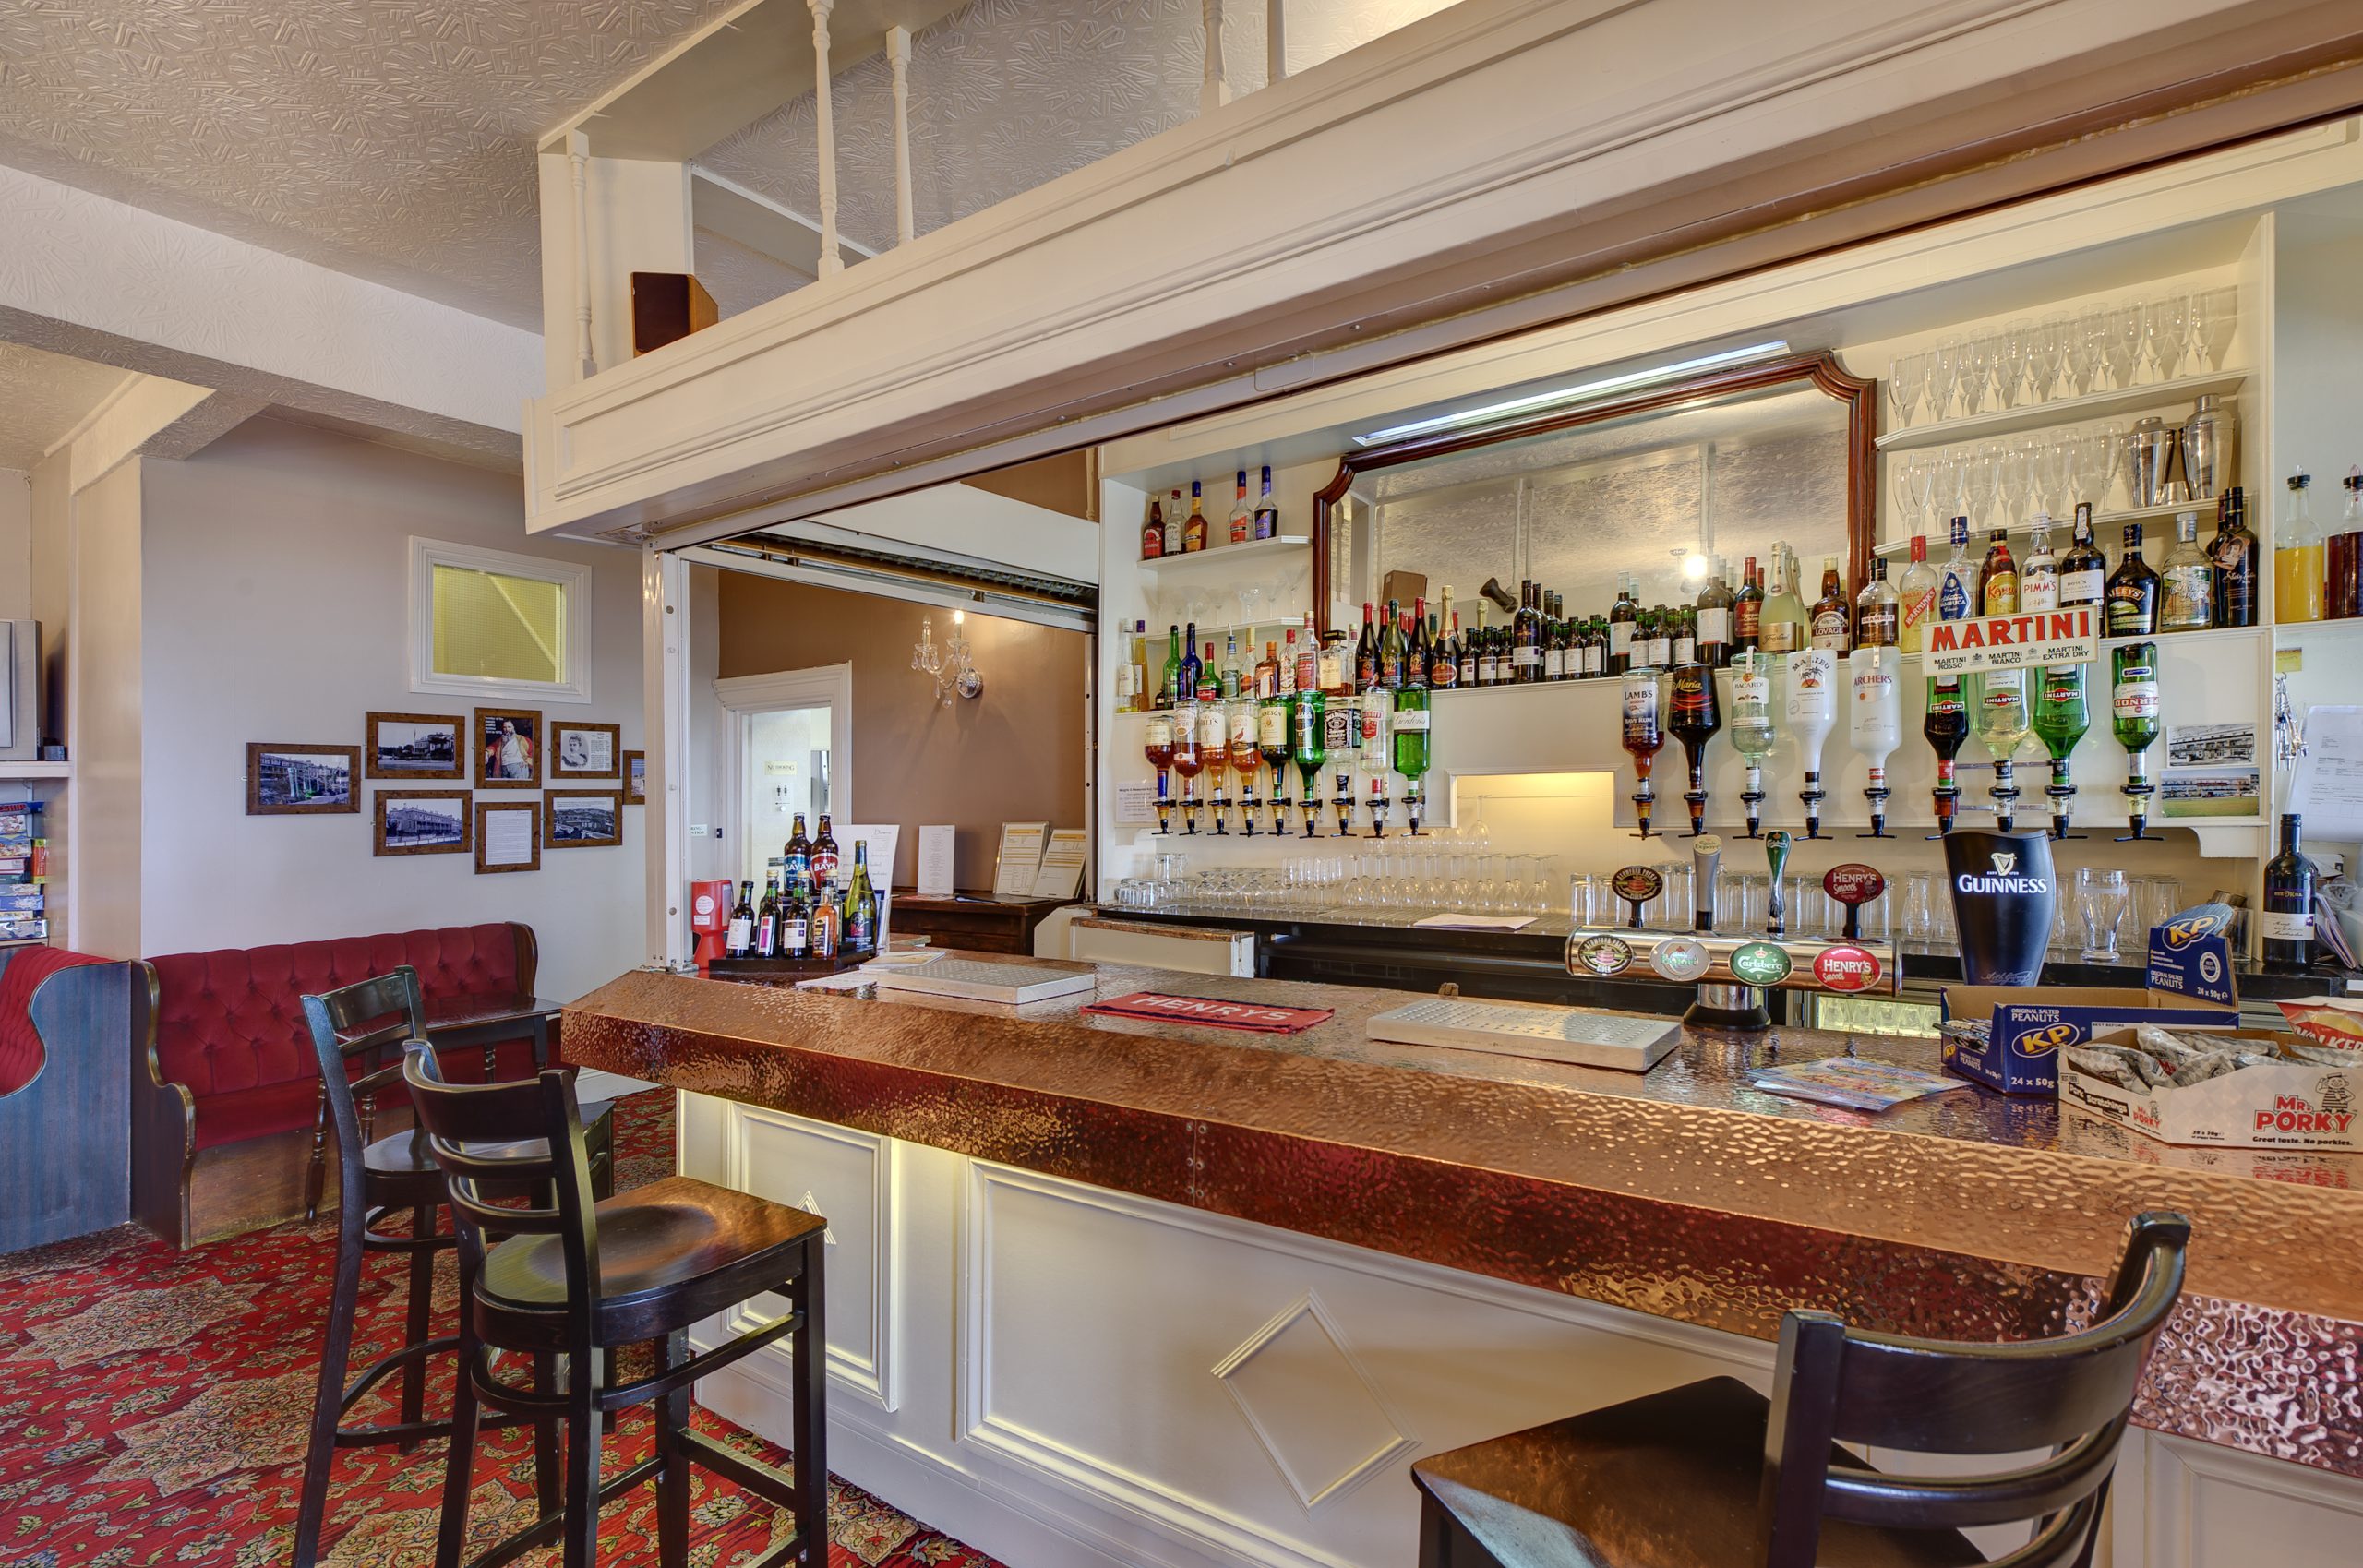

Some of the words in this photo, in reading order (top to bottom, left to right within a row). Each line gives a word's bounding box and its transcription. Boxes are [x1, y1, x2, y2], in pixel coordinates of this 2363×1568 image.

[2023, 581, 2057, 593] PIMM'S
[2109, 587, 2142, 599] ILEYS
[1904, 589, 1936, 626] WARNINKS
[1815, 627, 1844, 636] LOVAGE
[1930, 610, 2091, 652] MARTINI
[2047, 645, 2083, 653] MARTINI
[1934, 656, 1967, 665] MARTINI
[1989, 651, 2023, 660] MARTINI
[1992, 657, 2021, 665] BIANCO
[2043, 652, 2070, 661] EXTRA
[2072, 650, 2090, 658] DRY
[1792, 657, 1830, 672] MAIBU
[1853, 675, 1893, 686] ARCHERS
[1625, 690, 1653, 700] LAMB'S
[1985, 695, 2020, 704] MARTINI
[2044, 690, 2080, 699] MARTINI
[1395, 715, 1426, 725] Gordon's
[814, 863, 836, 871] BAYS
[1833, 872, 1877, 883] HENRY'S
[1958, 874, 2047, 893] GUINNESS
[2169, 917, 2213, 944] KP
[1737, 956, 1783, 974] Carlsberg
[1823, 959, 1872, 973] HENRY'S
[1822, 972, 1845, 983] Smooth
[2151, 976, 2184, 990] PEANUTS
[2197, 987, 2204, 995] 24
[1132, 995, 1293, 1021] HENRYS
[2011, 1013, 2060, 1023] PEANUTS
[2021, 1025, 2071, 1053] KP
[2011, 1076, 2024, 1085] 24
[2035, 1078, 2055, 1089] 50g
[2132, 1110, 2163, 1129] PORKY
[2254, 1110, 2356, 1133] PORKY
